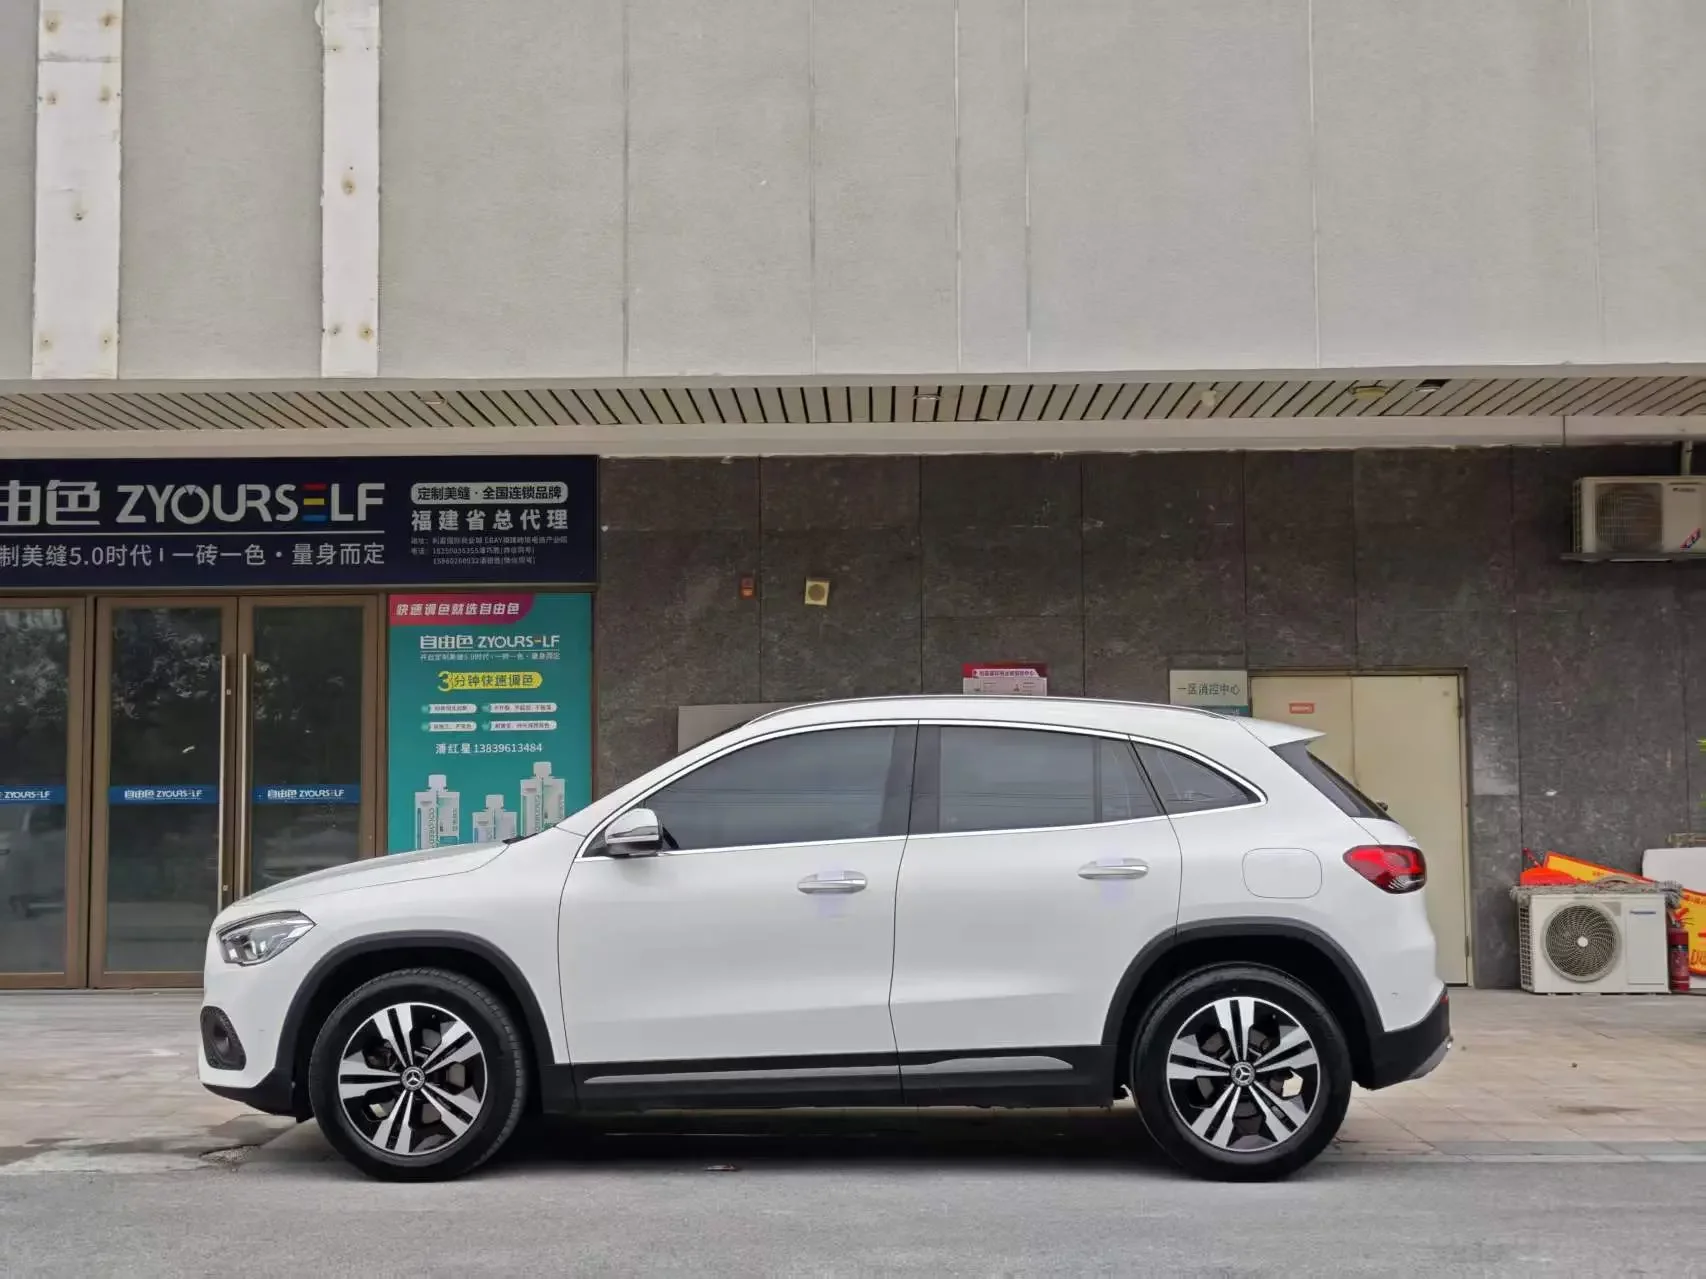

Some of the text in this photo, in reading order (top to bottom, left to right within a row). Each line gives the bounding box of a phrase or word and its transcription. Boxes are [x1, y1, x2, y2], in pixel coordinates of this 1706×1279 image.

[0, 480, 386, 526] 由色 ZYOURSELF
[411, 508, 569, 532] 福建省总代理
[396, 602, 520, 616] 快速调色就选自由色
[420, 634, 474, 650] 自由色
[437, 670, 534, 692] 3分钟快速调色
[474, 742, 543, 753] 13839613484
